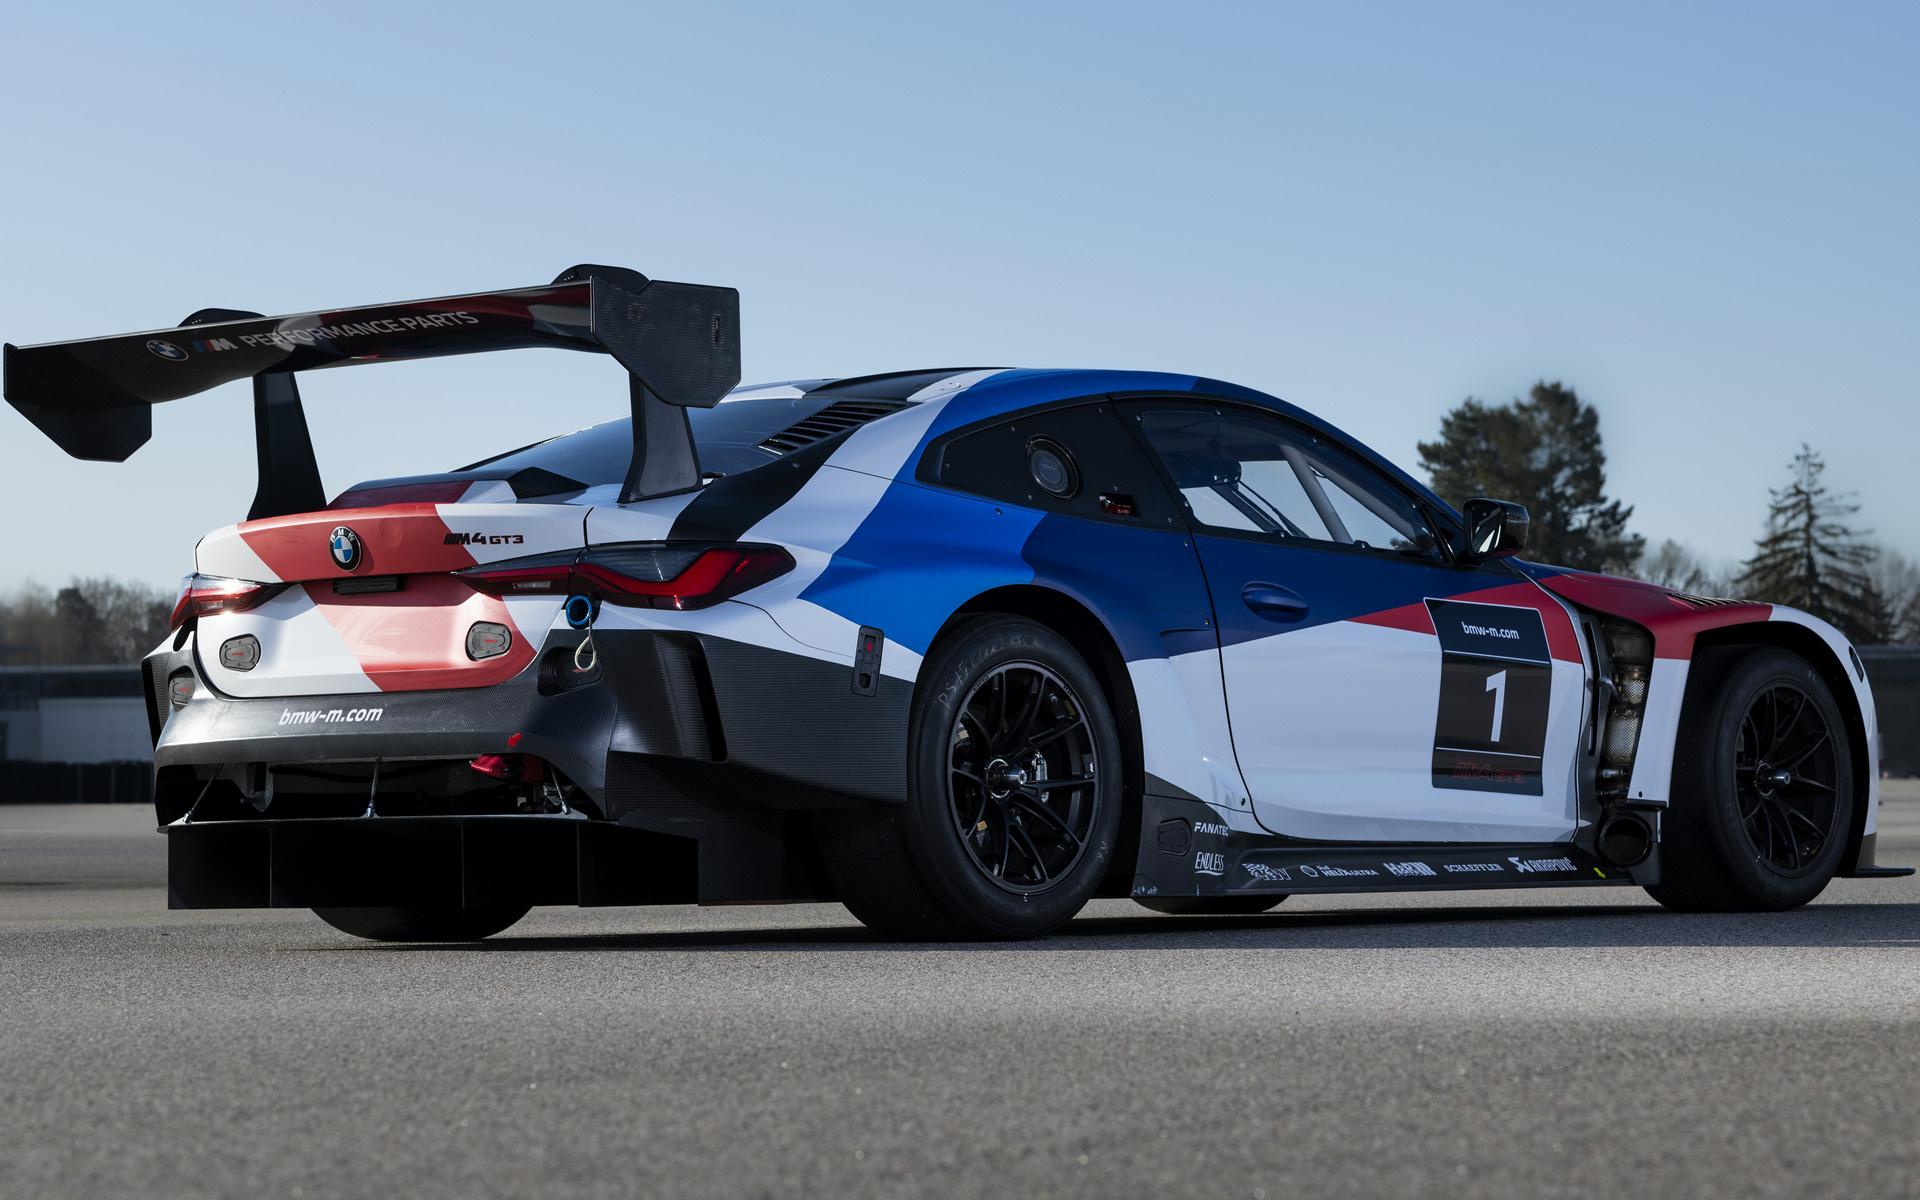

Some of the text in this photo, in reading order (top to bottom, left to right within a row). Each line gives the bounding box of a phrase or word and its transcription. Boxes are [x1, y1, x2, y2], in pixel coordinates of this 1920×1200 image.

[239, 319, 406, 348] PERFORMANCE
[398, 311, 479, 330] PARTS
[489, 534, 524, 545] GT3
[1461, 621, 1520, 640] bmw-m.com
[1485, 669, 1507, 743] 1
[278, 707, 384, 726] bmw-m.com
[1194, 821, 1230, 837] FANATEC
[1194, 851, 1225, 872] ENDLESS
[1443, 863, 1505, 873] SCHAEFFLER
